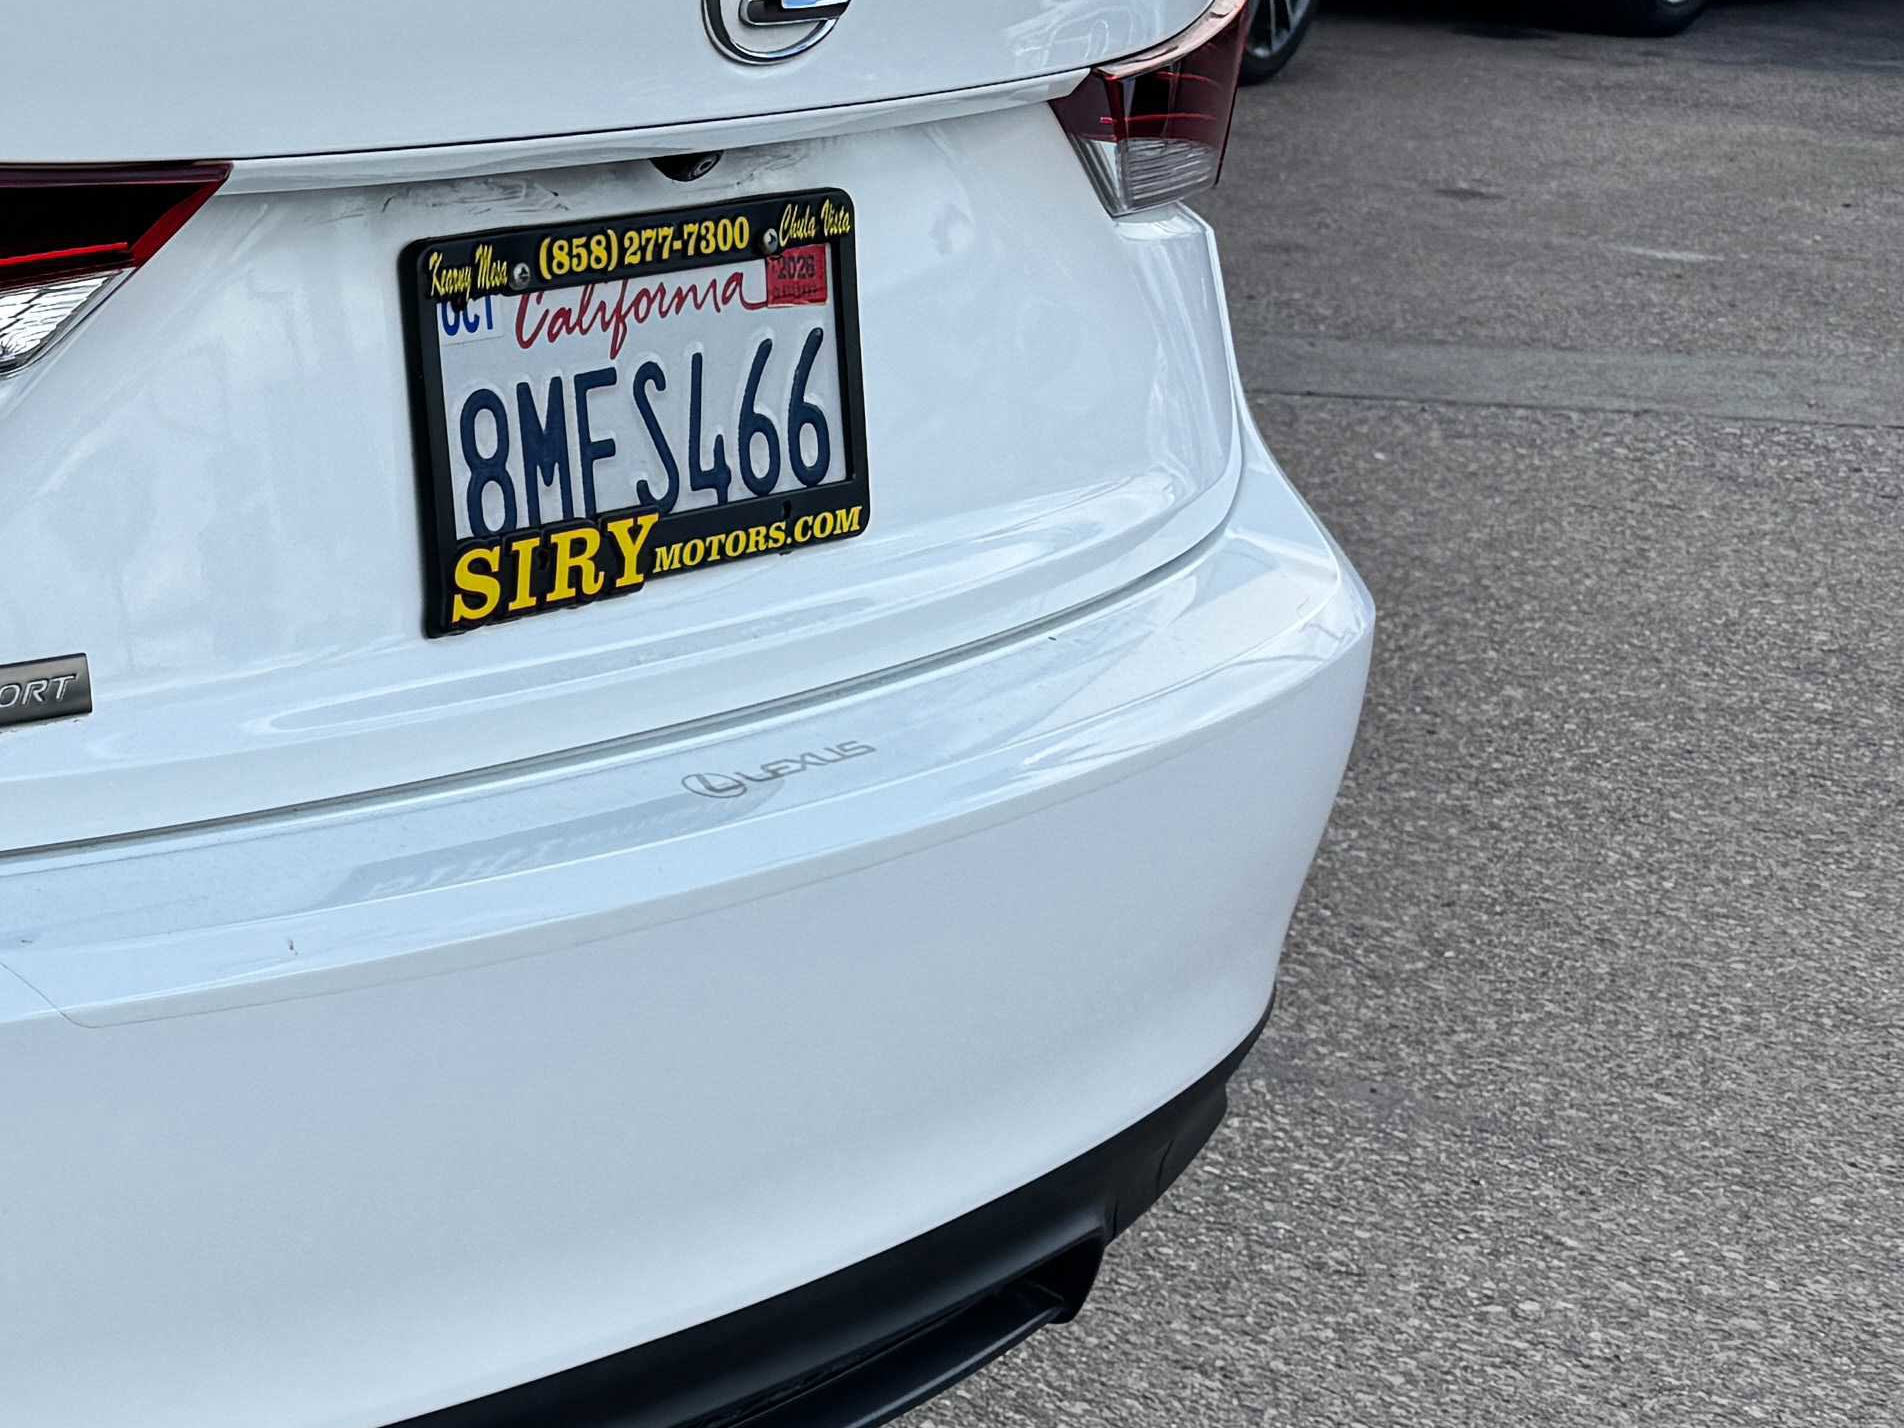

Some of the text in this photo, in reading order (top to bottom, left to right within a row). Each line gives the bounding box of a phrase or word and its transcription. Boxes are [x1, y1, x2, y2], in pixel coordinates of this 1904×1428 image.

[779, 198, 851, 248] Chula Vista
[428, 243, 509, 302] Kearny Mesa
[514, 271, 768, 360] California
[459, 326, 832, 538] 8MFS466
[736, 739, 877, 783] LEXUS
